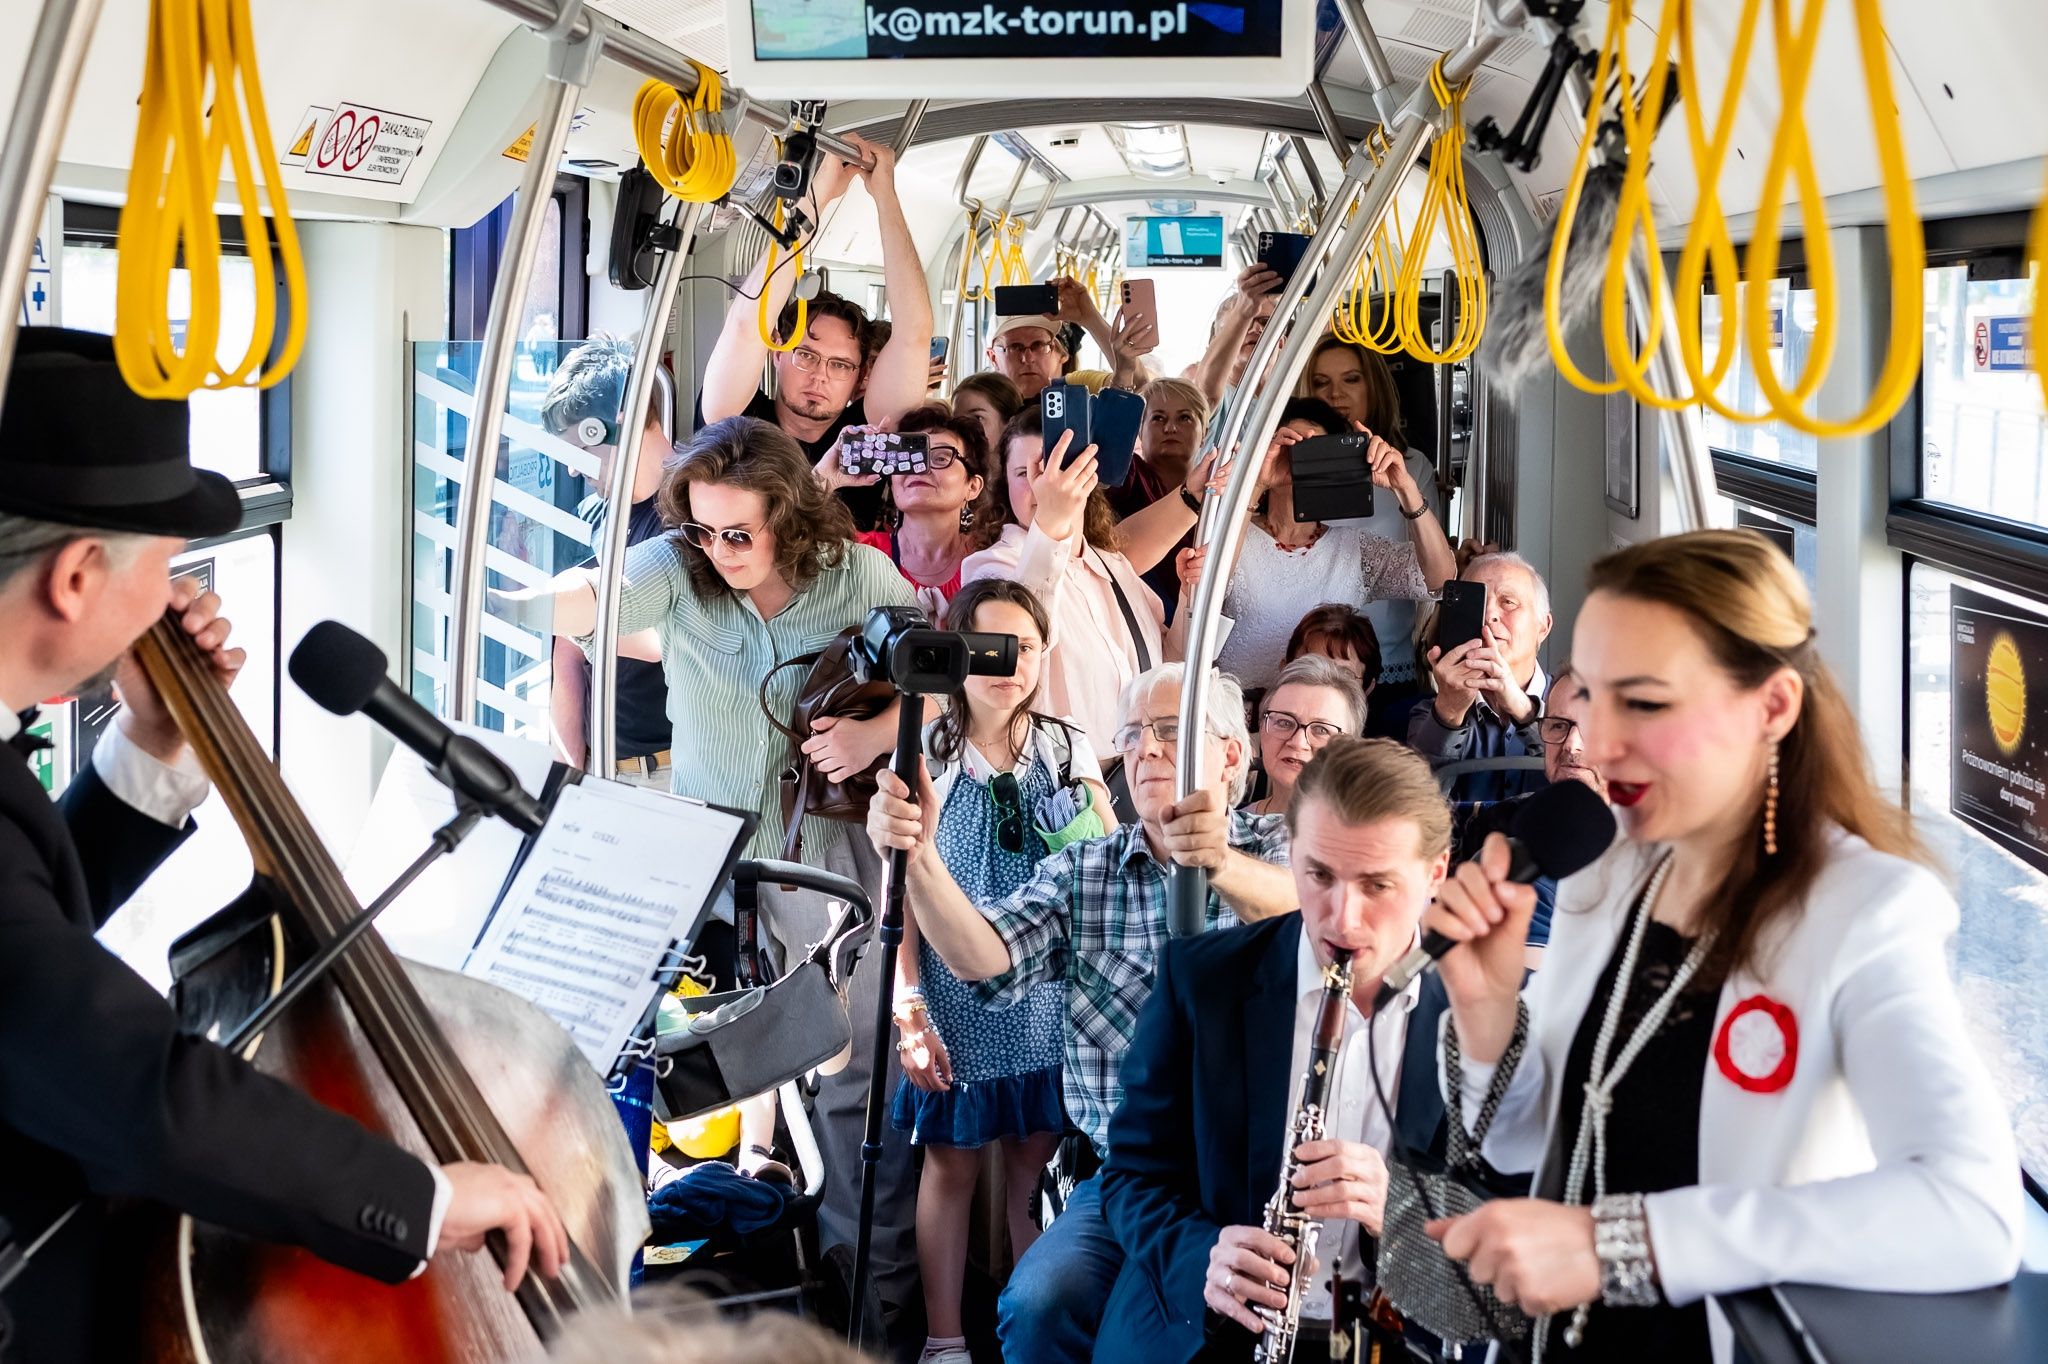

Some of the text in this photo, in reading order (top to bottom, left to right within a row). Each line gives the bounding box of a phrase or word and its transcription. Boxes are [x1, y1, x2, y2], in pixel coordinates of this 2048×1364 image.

[867, 3, 1187, 41] k@mzk-torun.pl
[380, 121, 425, 140] ZAKAZ PALENIA
